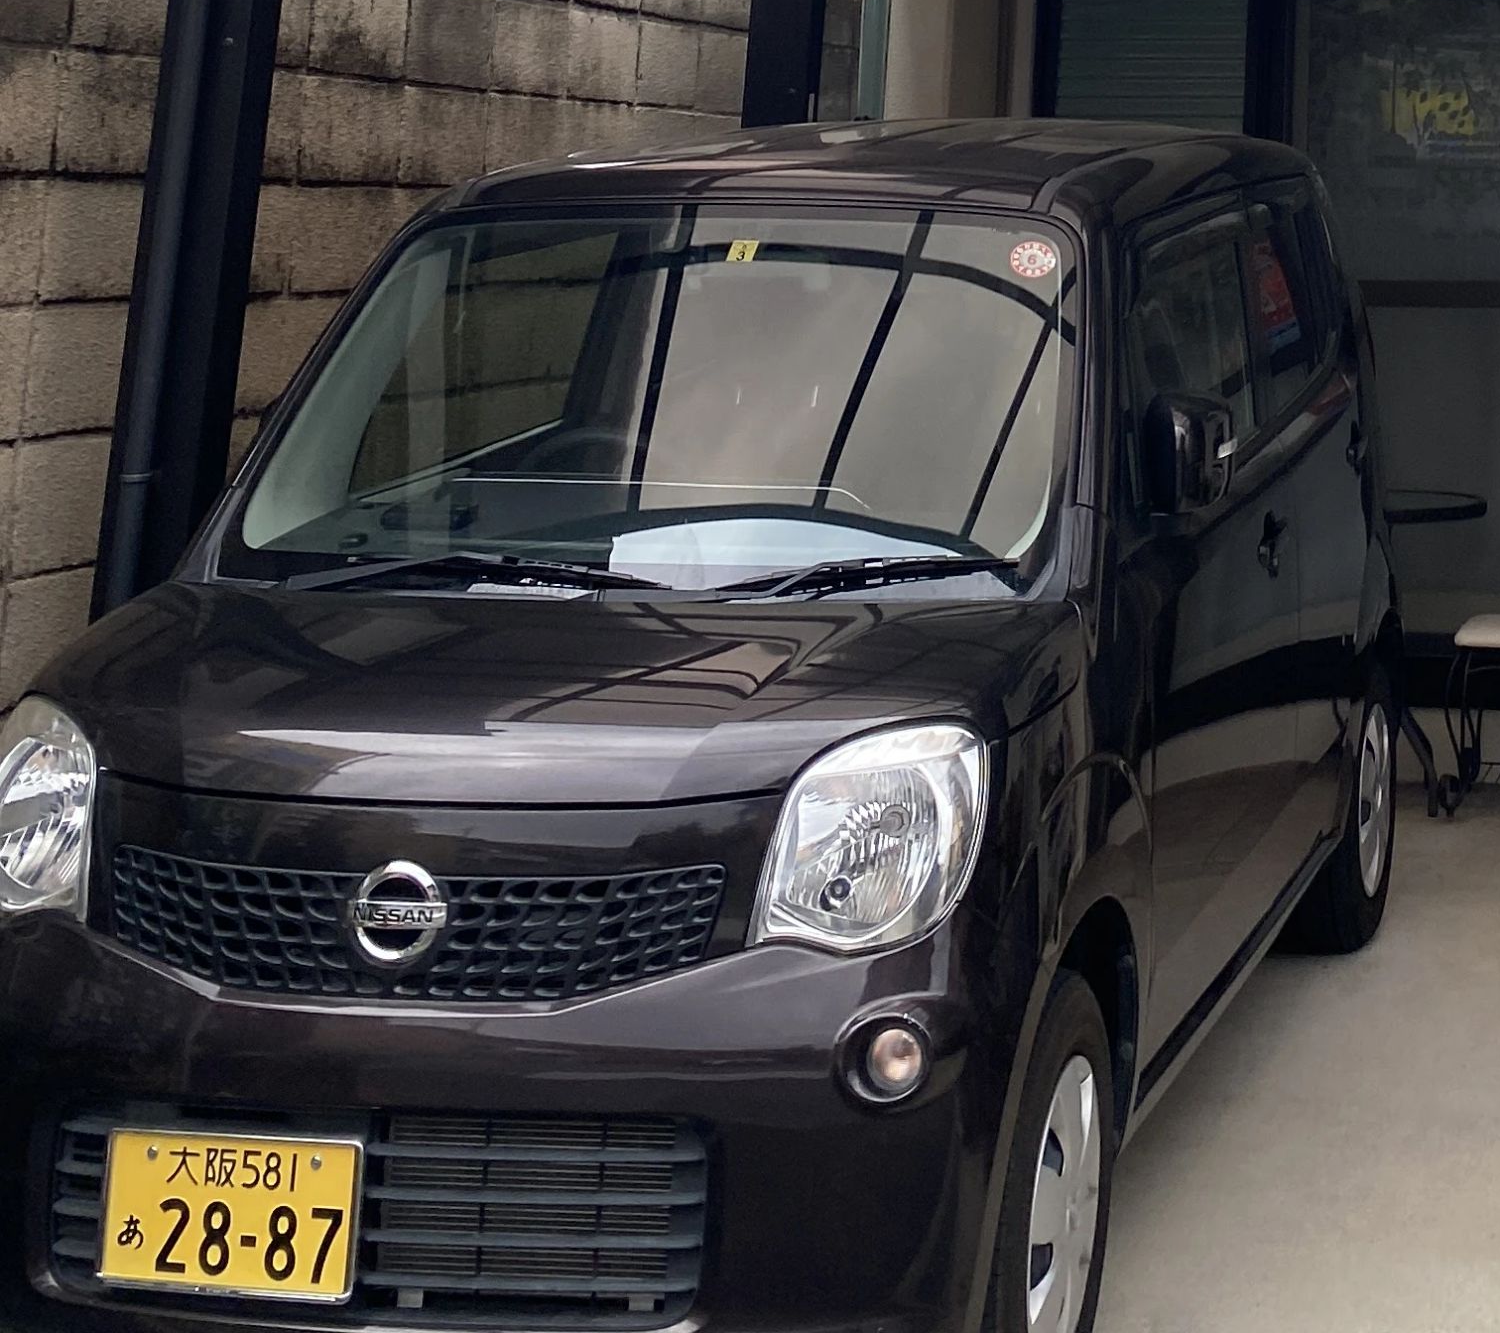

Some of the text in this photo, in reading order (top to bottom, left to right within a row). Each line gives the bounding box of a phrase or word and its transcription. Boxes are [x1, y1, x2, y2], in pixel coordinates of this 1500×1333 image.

[735, 251, 746, 262] 3
[353, 906, 434, 924] NISSAN
[117, 1197, 344, 1285] あ 28-87
